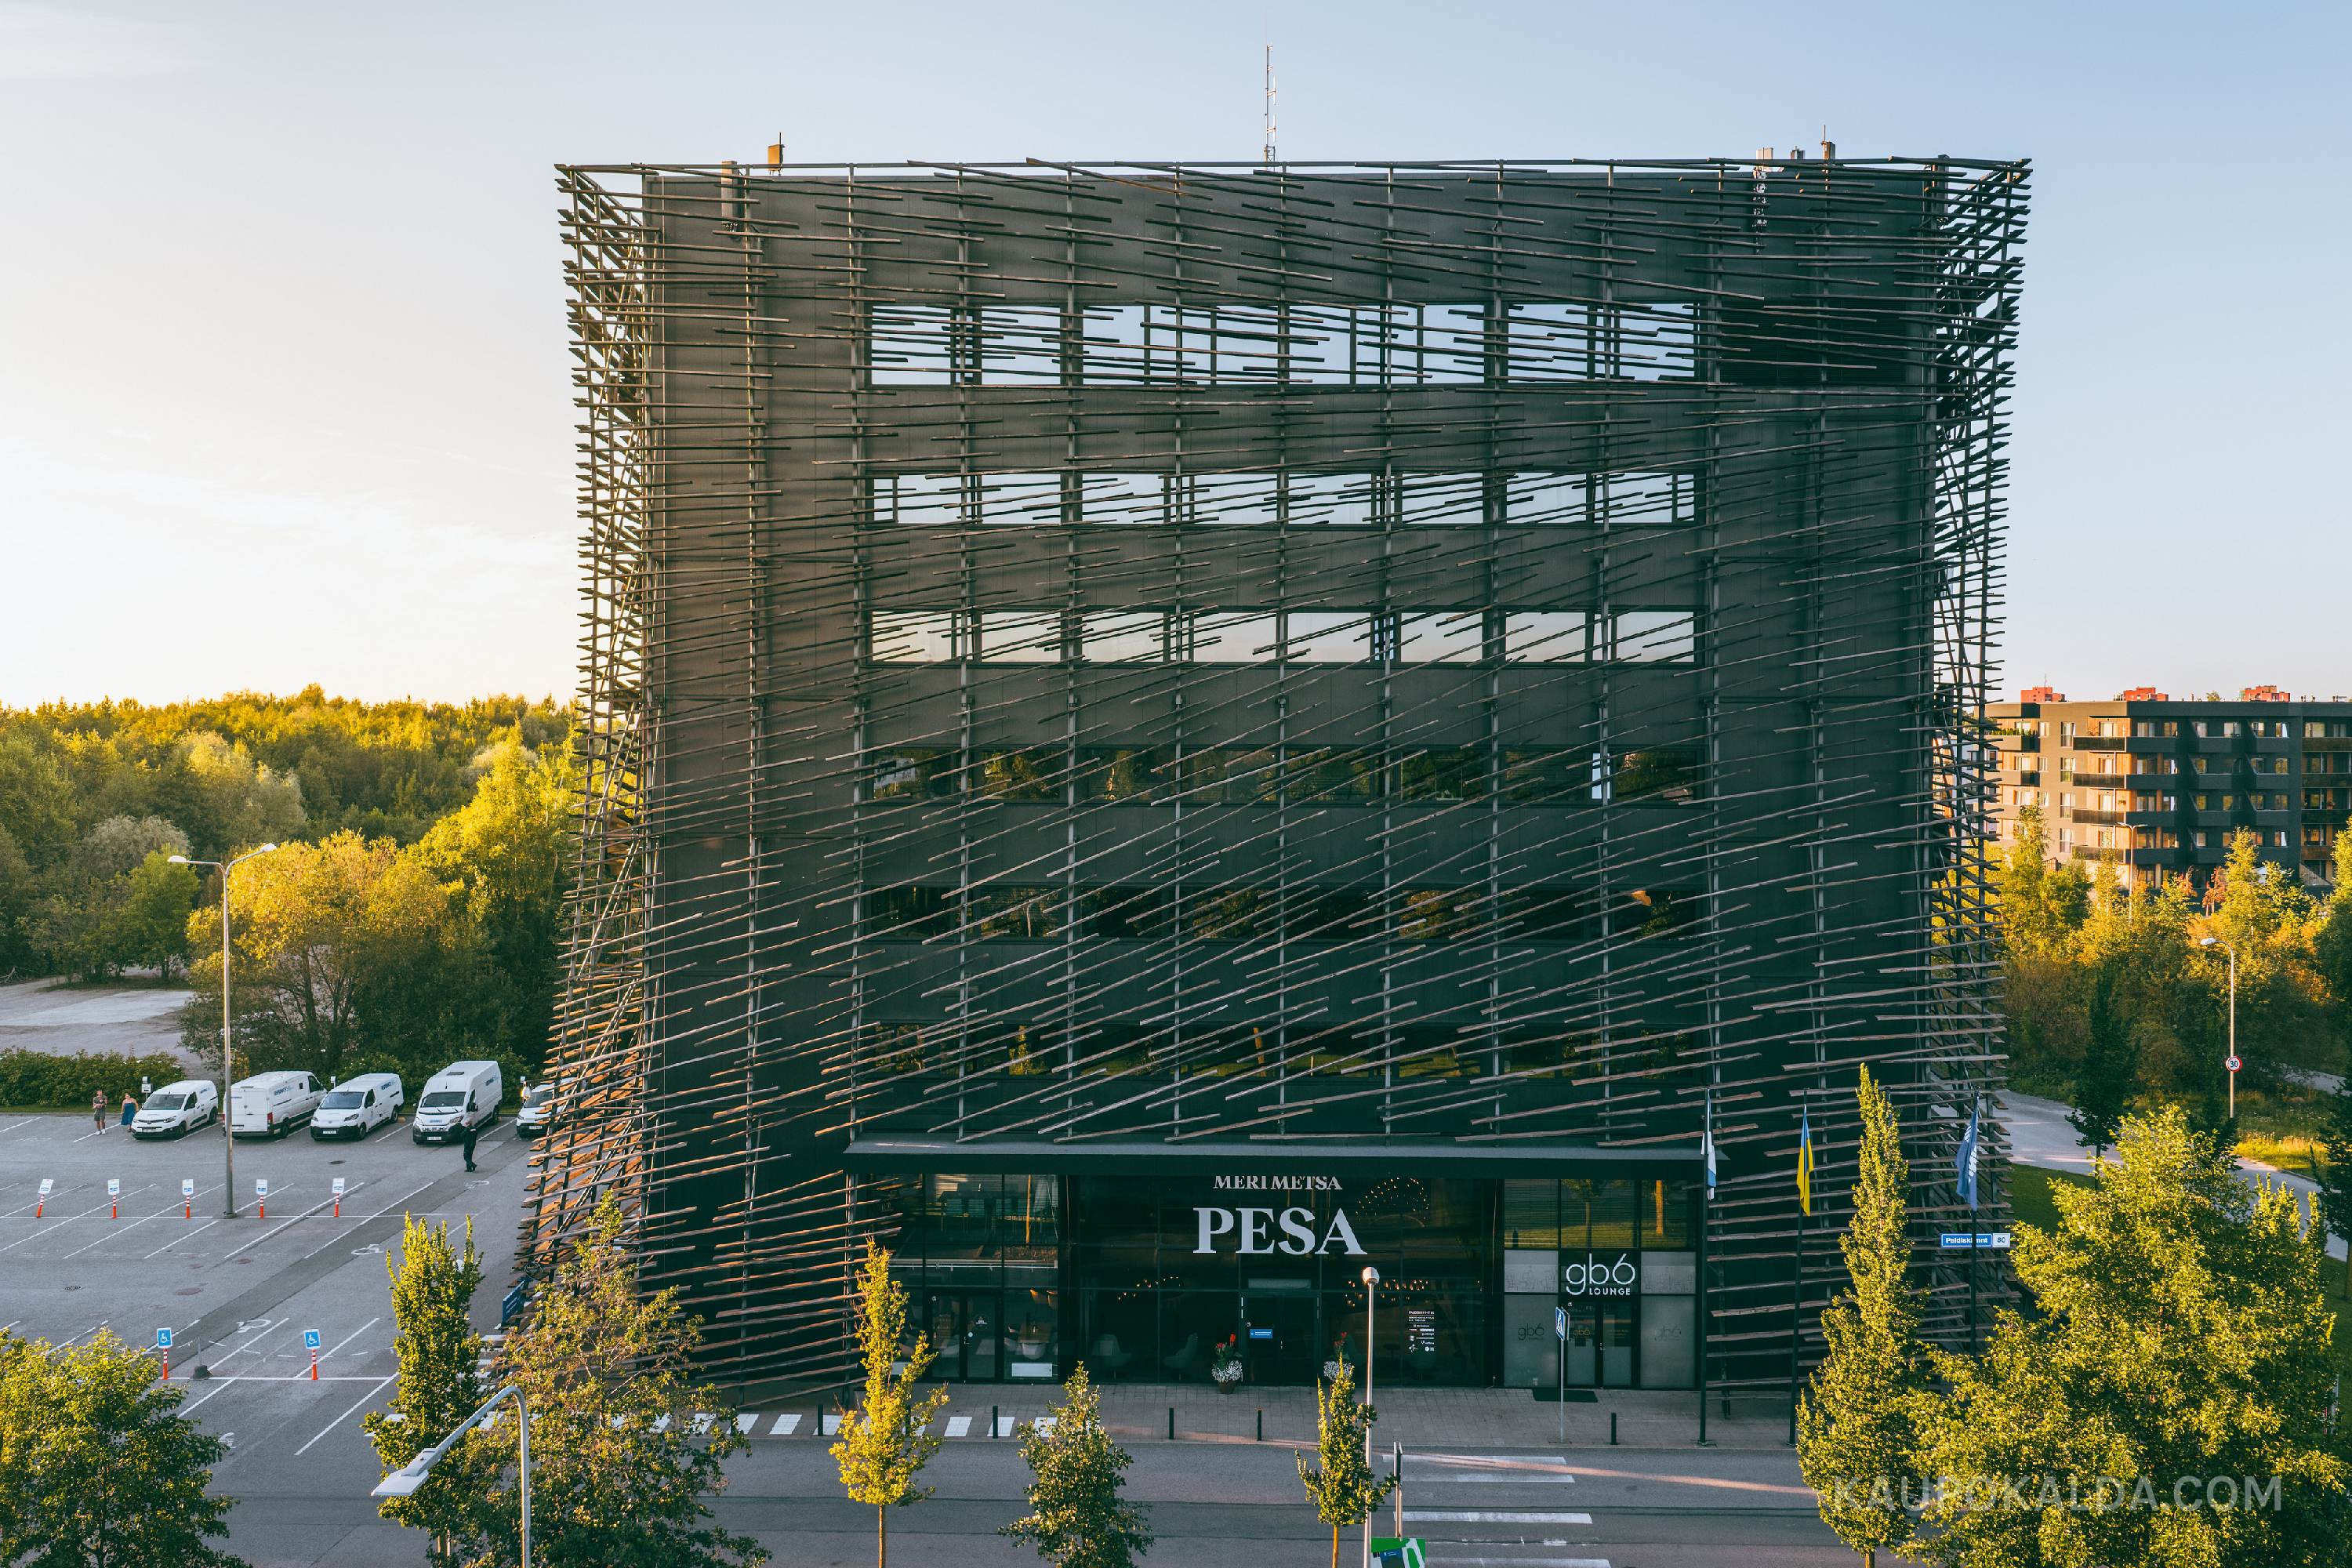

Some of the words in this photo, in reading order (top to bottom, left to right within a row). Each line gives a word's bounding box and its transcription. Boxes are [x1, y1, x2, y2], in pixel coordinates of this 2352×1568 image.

[1192, 1207, 1368, 1255] PESA
[1566, 1253, 1636, 1295] gb6
[1518, 1323, 1544, 1341] gb6
